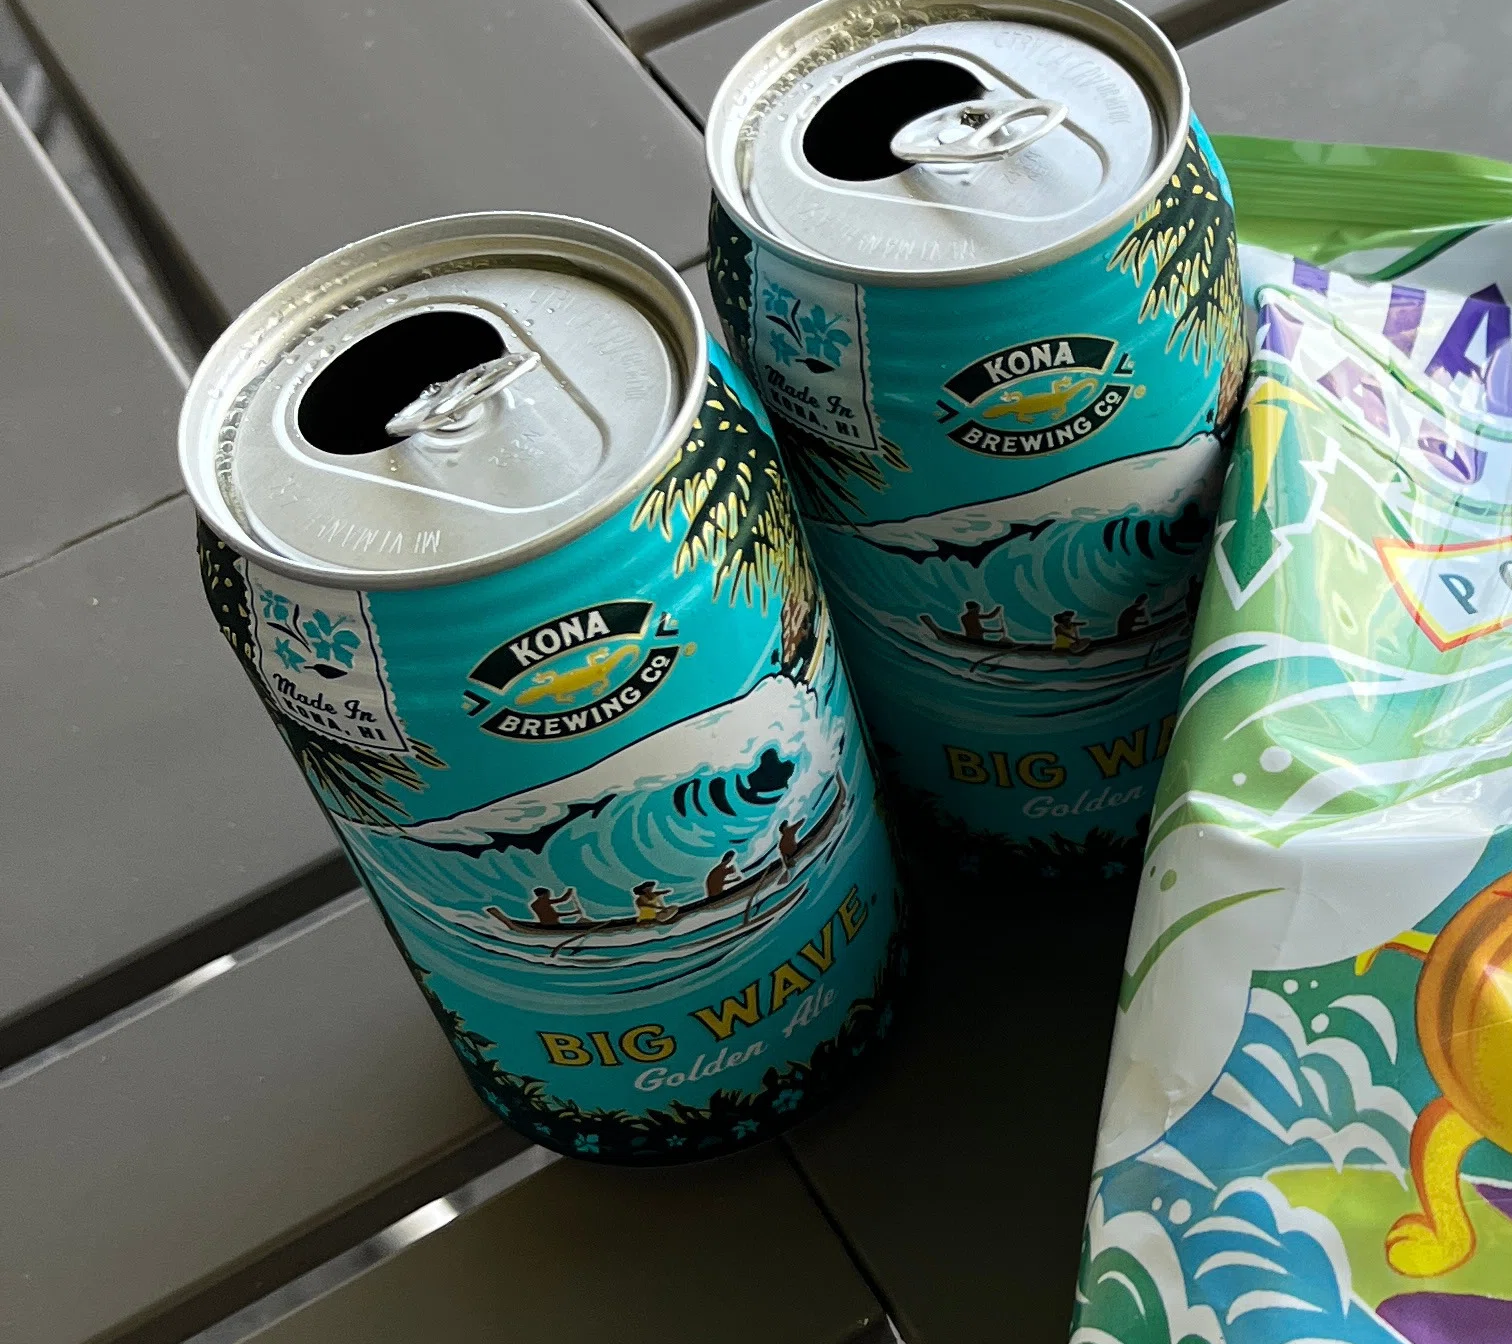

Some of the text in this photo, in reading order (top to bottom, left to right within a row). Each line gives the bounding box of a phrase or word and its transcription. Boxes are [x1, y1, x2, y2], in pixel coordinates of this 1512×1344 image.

[984, 342, 1076, 384] KONA
[765, 365, 855, 419] Made In
[962, 416, 1093, 453] BREWING
[510, 610, 611, 667] KONA
[273, 673, 378, 723] Made In
[499, 686, 642, 737] BREWING
[357, 725, 387, 741] HI
[941, 742, 1067, 790] BIG
[1021, 784, 1147, 819] Golden
[536, 883, 869, 1067] BIG WAVE
[634, 983, 837, 1093] Golden Ale
